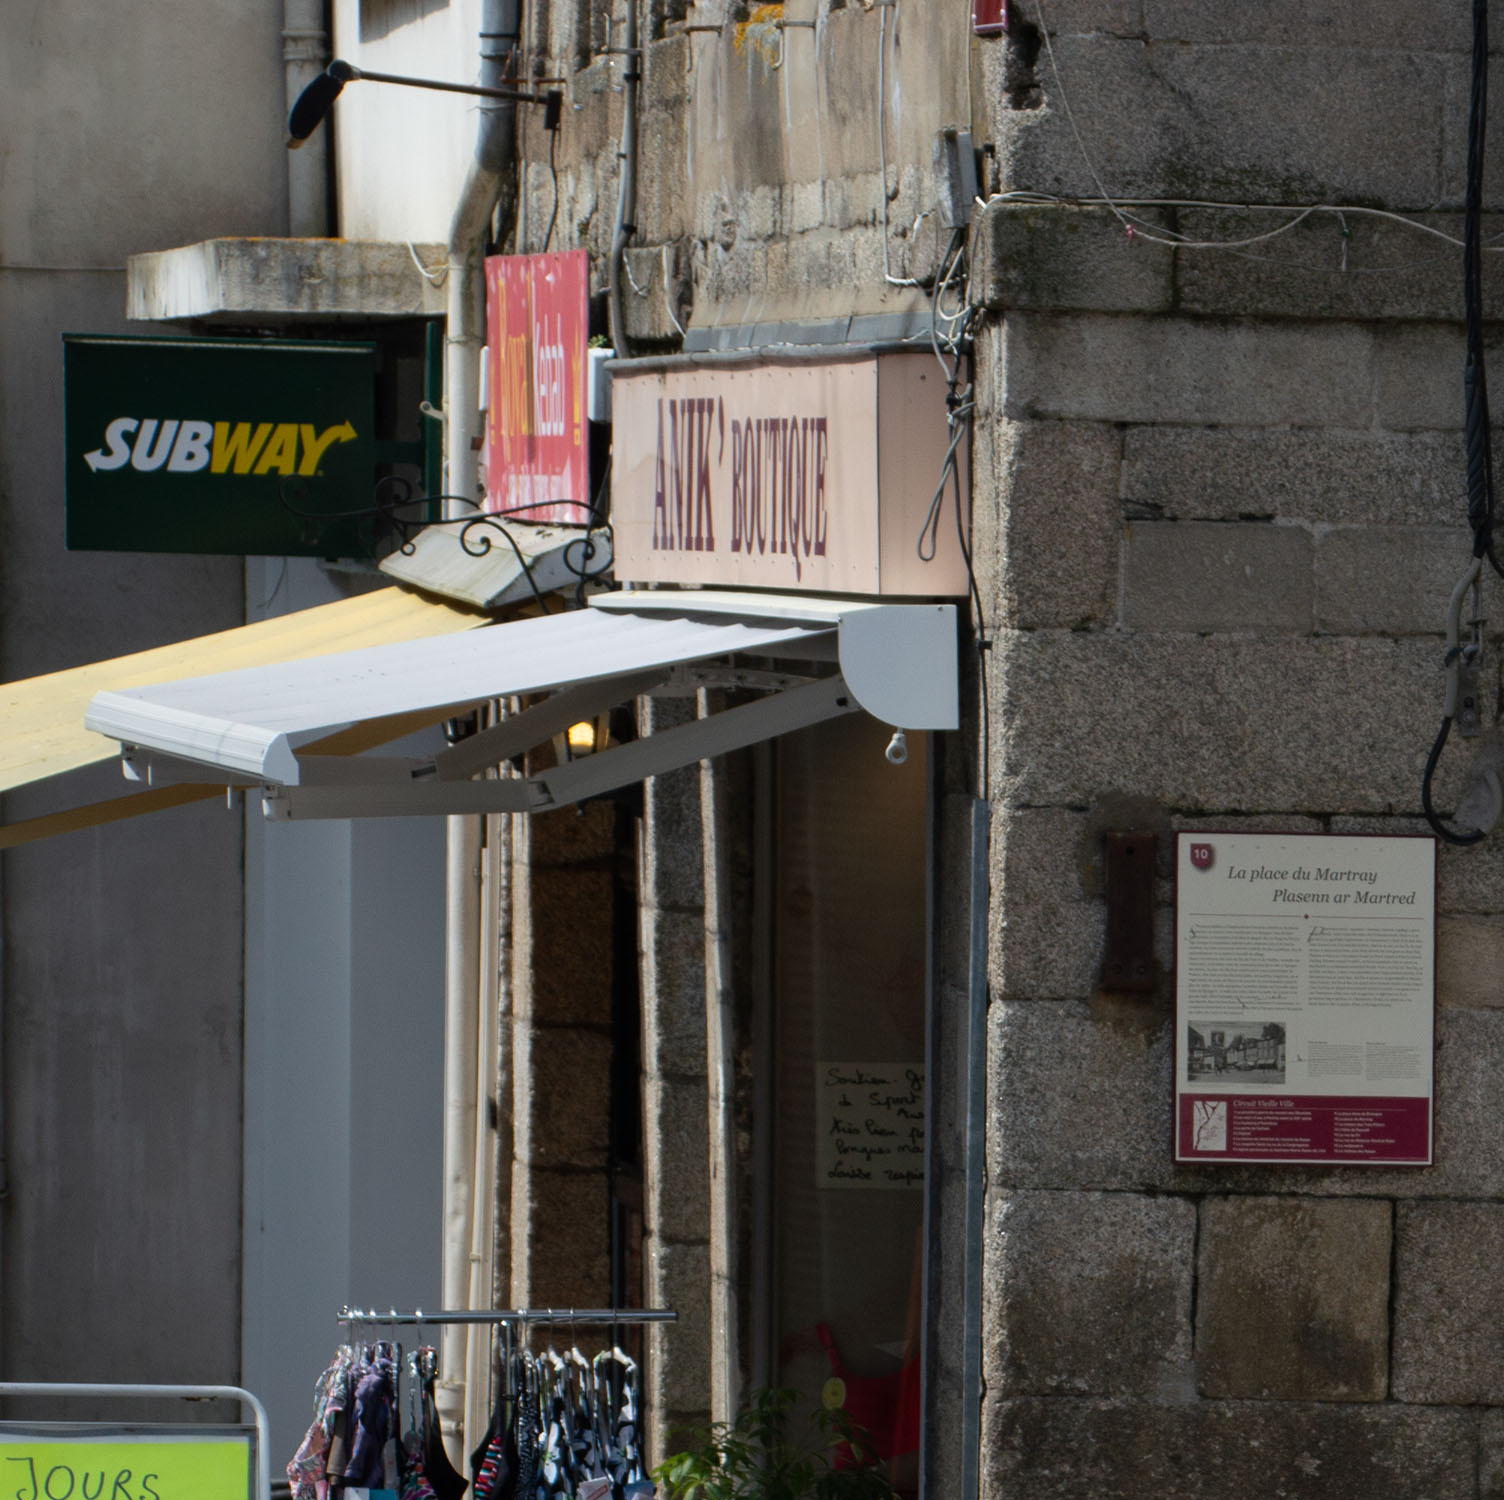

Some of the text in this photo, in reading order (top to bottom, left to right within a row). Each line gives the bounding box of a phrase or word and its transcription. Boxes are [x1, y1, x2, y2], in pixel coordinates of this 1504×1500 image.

[532, 279, 566, 437] Kebab
[84, 417, 358, 477] SUBWAY
[729, 416, 828, 581] BOUTIQUE
[1193, 849, 1208, 859] 10
[1227, 866, 1378, 885] La place du Martray
[1272, 889, 1416, 906] Plasenn ar Martred
